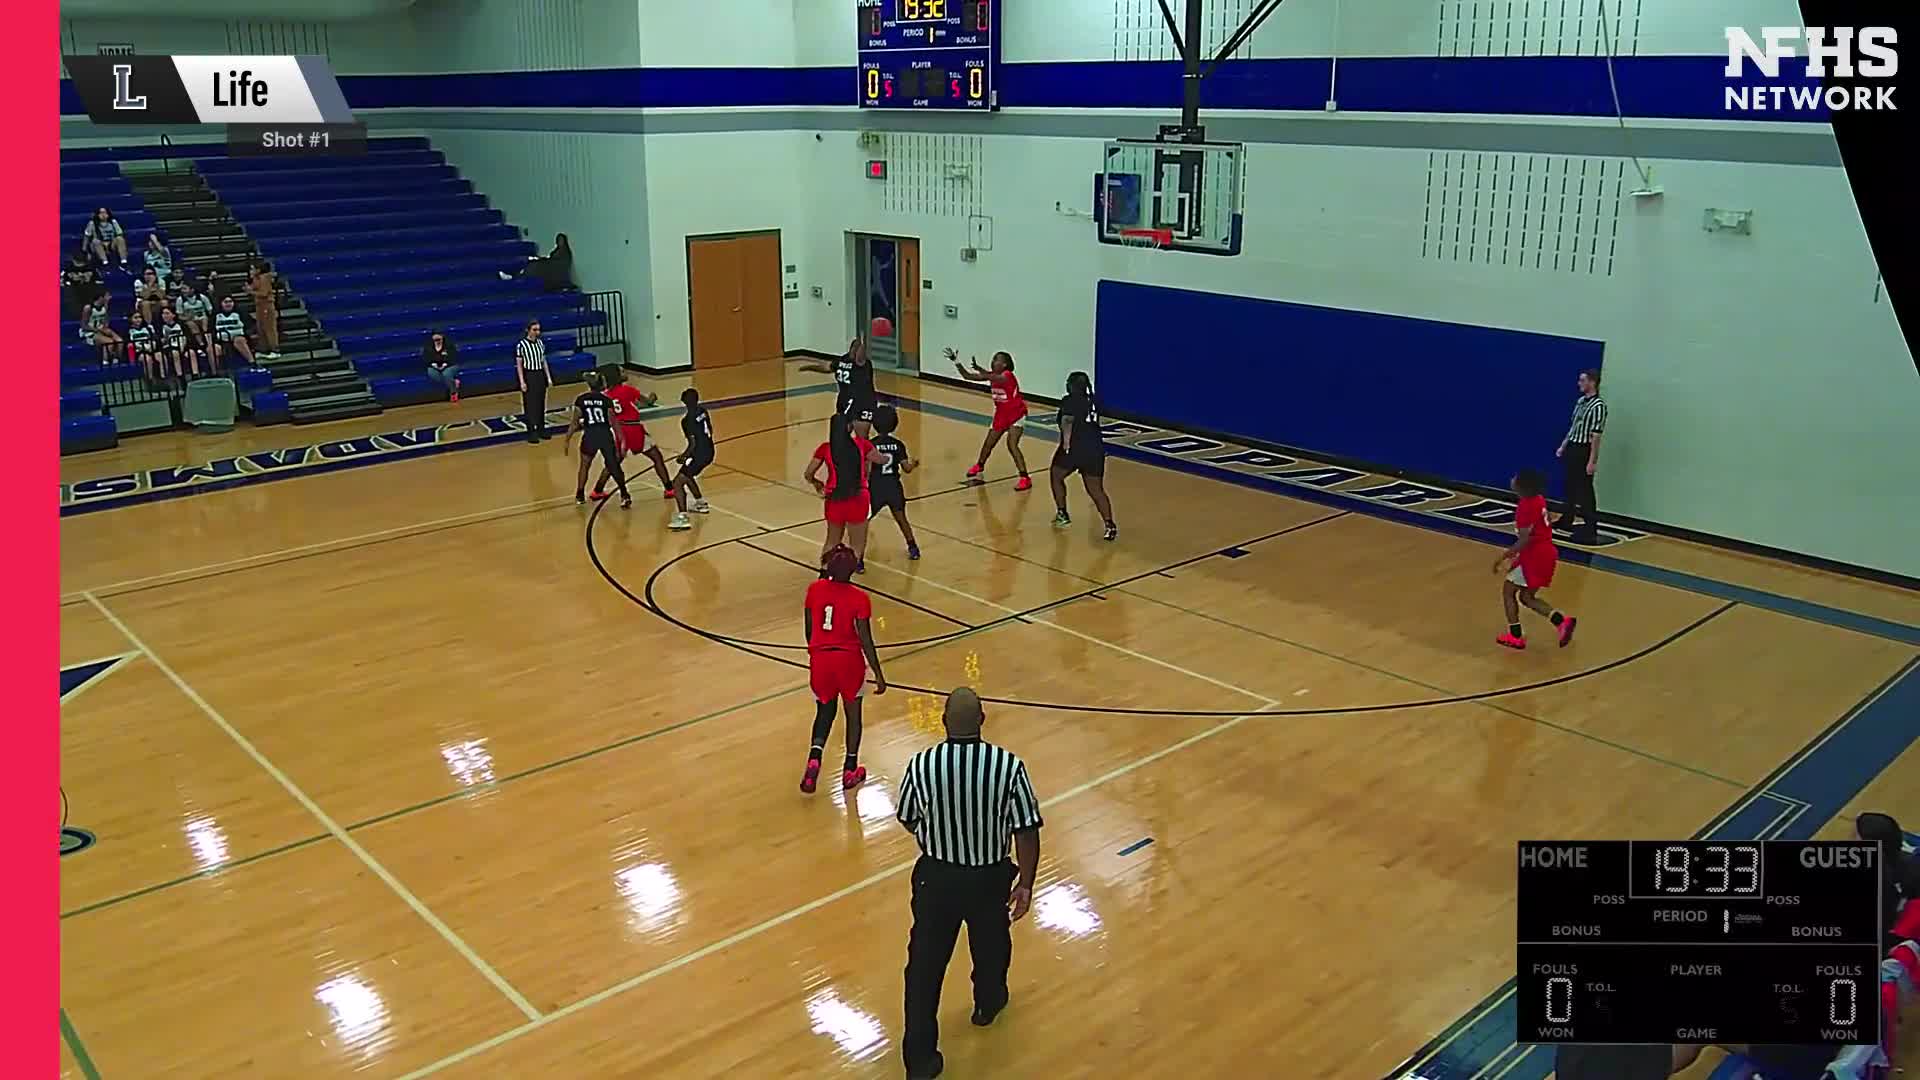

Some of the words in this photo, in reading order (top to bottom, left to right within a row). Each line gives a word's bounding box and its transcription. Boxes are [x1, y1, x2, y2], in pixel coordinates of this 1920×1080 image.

[903, 28, 924, 37] PERIOD
[956, 35, 977, 44] BONUS
[867, 69, 879, 98] 0
[951, 79, 961, 98] 5
[970, 68, 982, 98] 0
[836, 369, 851, 384] 32
[586, 407, 605, 424] 10
[612, 399, 622, 414] 5
[880, 453, 894, 474] 2
[822, 605, 833, 630] 1
